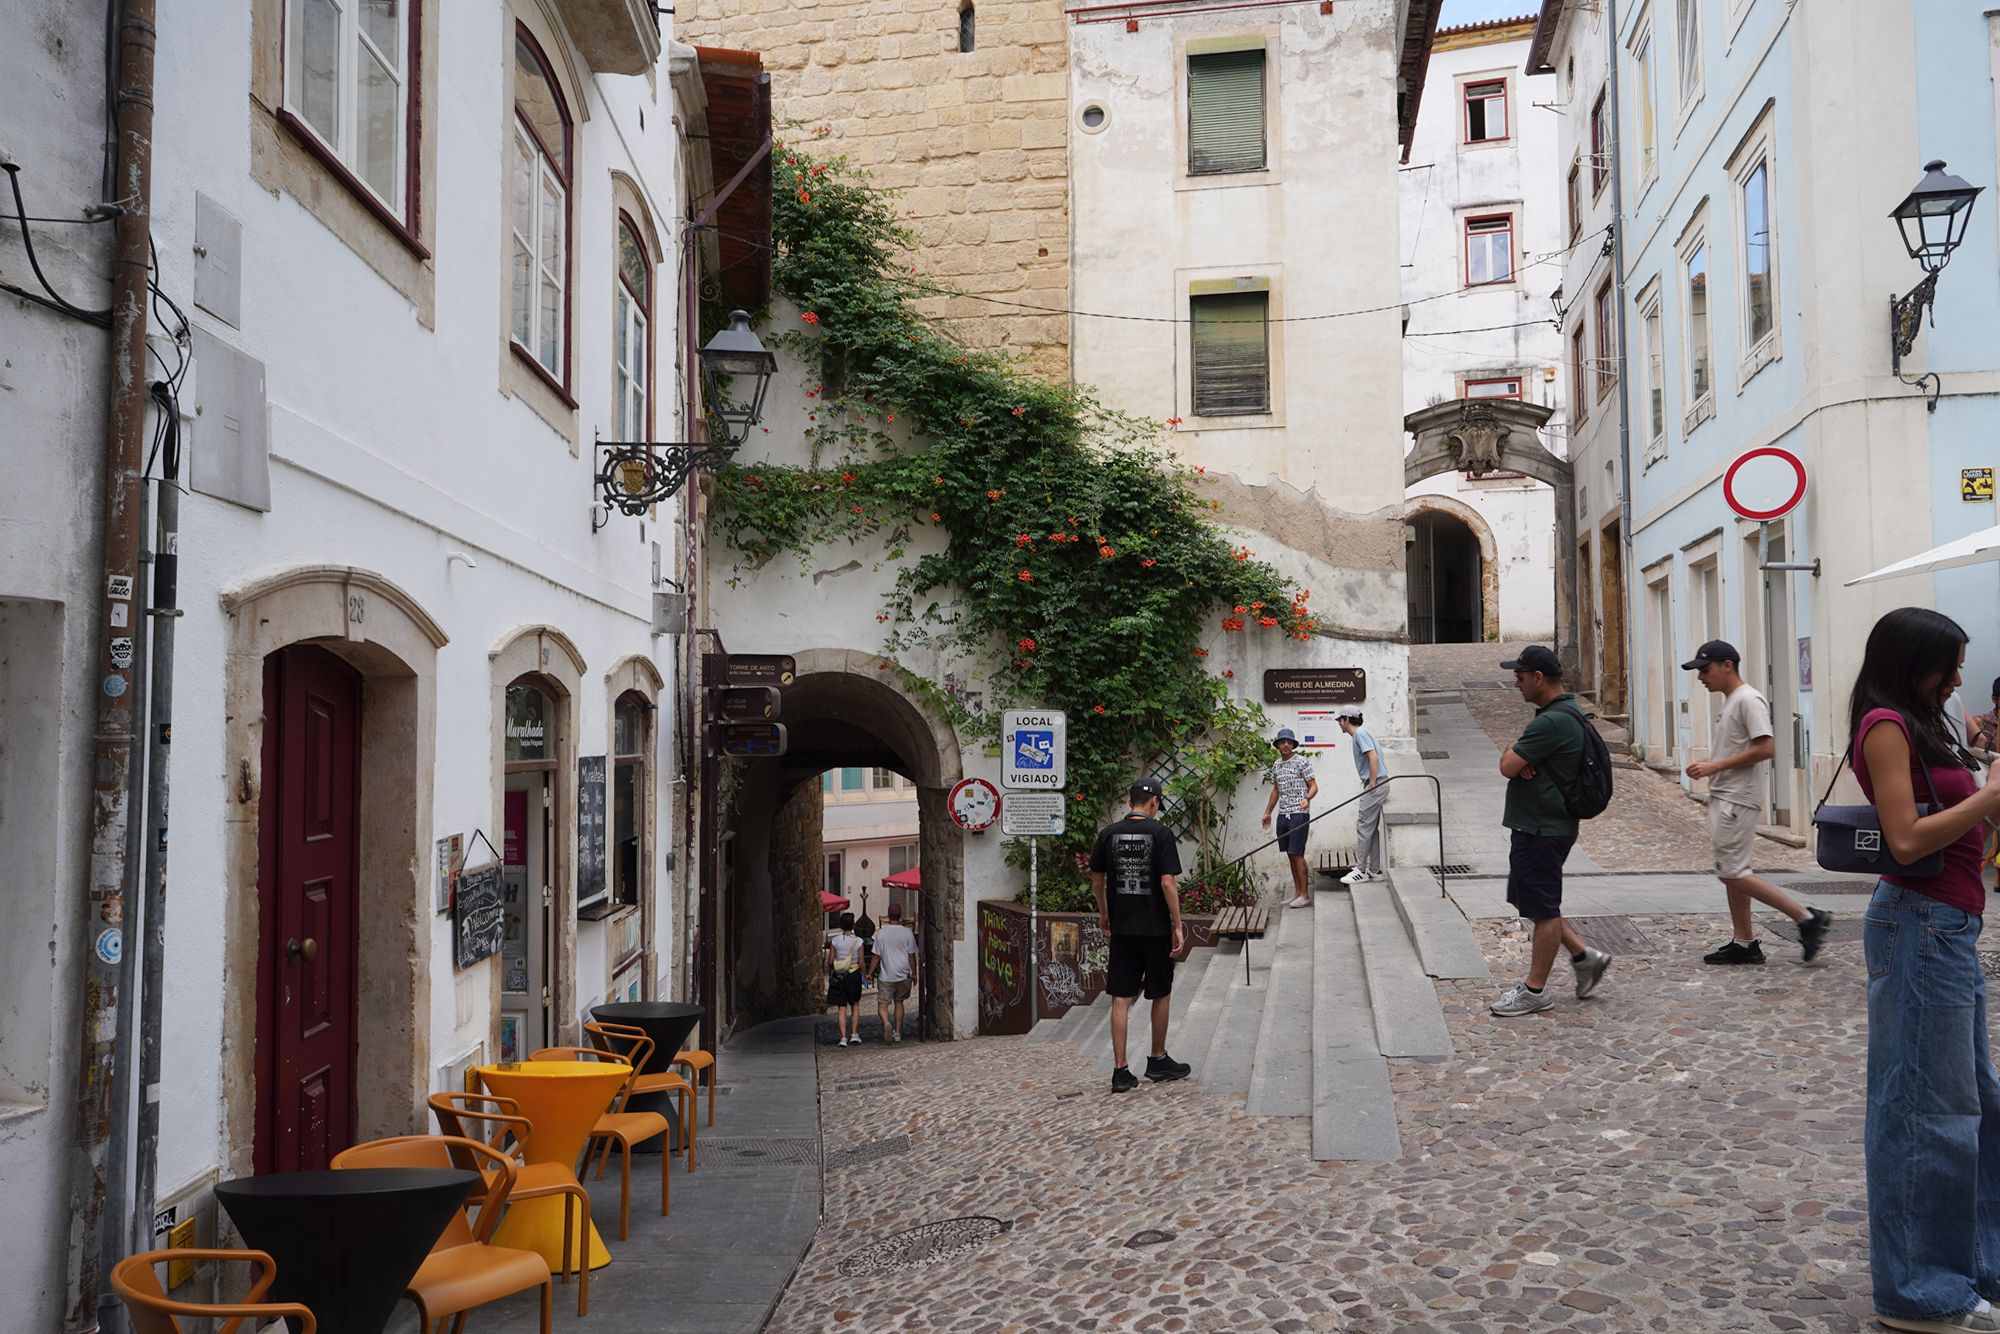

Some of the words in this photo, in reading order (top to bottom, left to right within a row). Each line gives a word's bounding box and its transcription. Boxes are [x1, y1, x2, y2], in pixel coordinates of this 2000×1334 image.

[111, 578, 129, 587] JUAN
[108, 586, 130, 596] GALGO
[349, 595, 364, 624] 28
[1274, 681, 1301, 689] TORRE
[1016, 717, 1053, 726] LOCAL
[507, 717, 543, 738] Muralhada
[1010, 774, 1058, 784] VIGIADO
